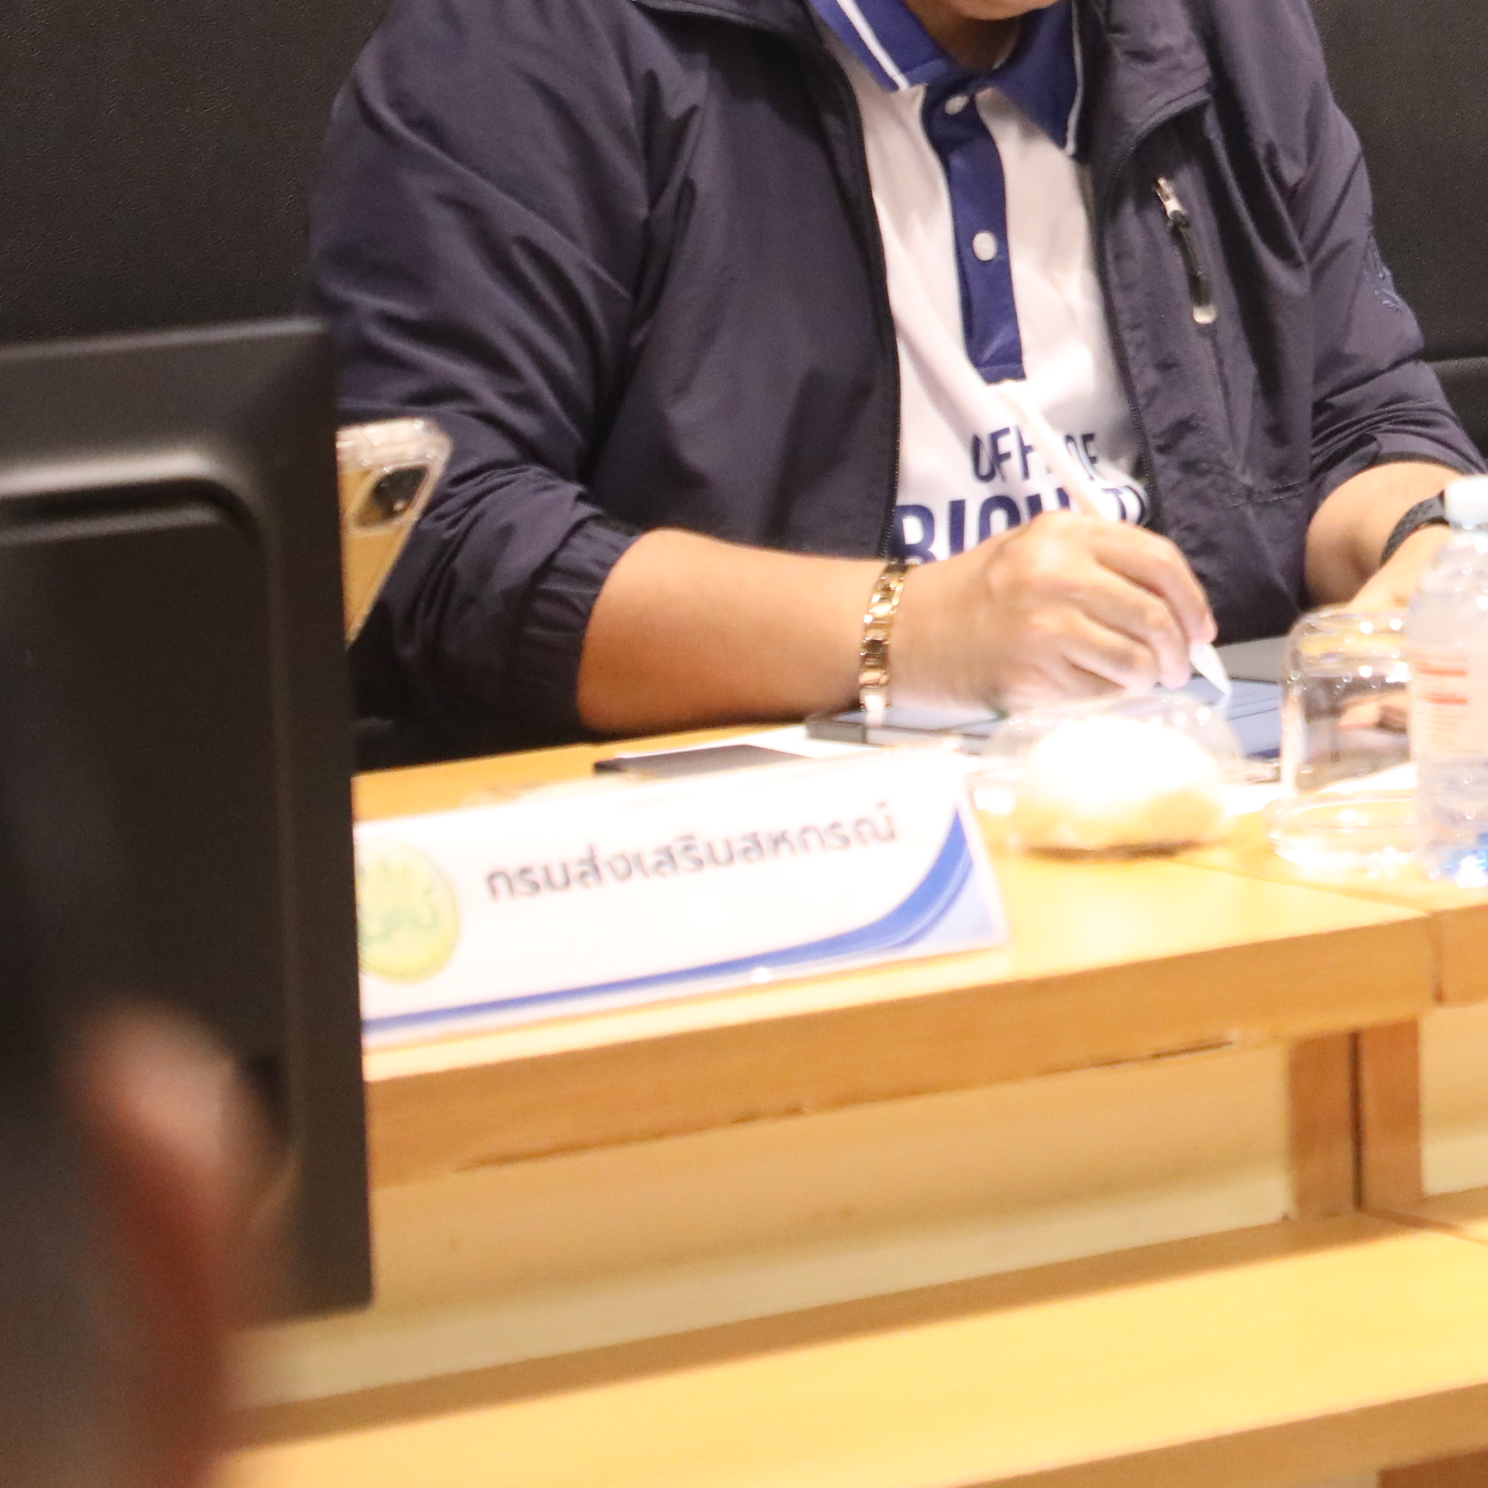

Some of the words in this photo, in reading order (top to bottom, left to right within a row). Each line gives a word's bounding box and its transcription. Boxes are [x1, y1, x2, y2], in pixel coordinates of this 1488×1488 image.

[487, 801, 899, 901] กรมส่งเสริมสหกรณ์
